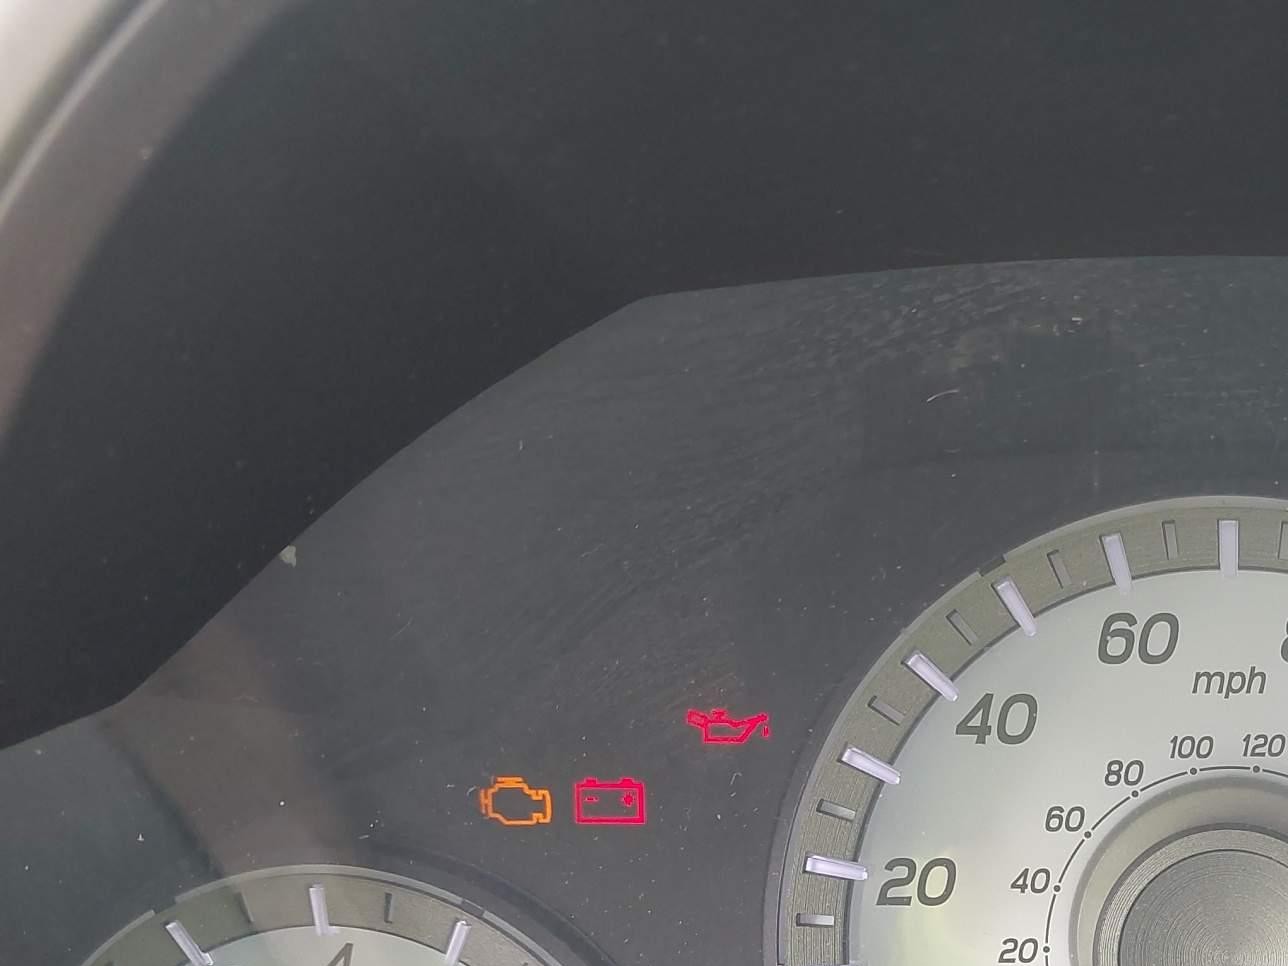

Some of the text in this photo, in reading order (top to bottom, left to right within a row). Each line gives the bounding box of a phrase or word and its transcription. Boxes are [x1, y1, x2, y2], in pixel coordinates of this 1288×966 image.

[1098, 613, 1179, 665] 60
[1192, 667, 1267, 698] mph
[955, 693, 1038, 744] 40
[1169, 735, 1214, 759] 100
[1242, 734, 1286, 757] 120
[1104, 760, 1144, 786] 80
[1045, 806, 1085, 833] 60
[877, 857, 956, 906] 20
[1010, 868, 1051, 893] 40
[998, 938, 1038, 964] 20
